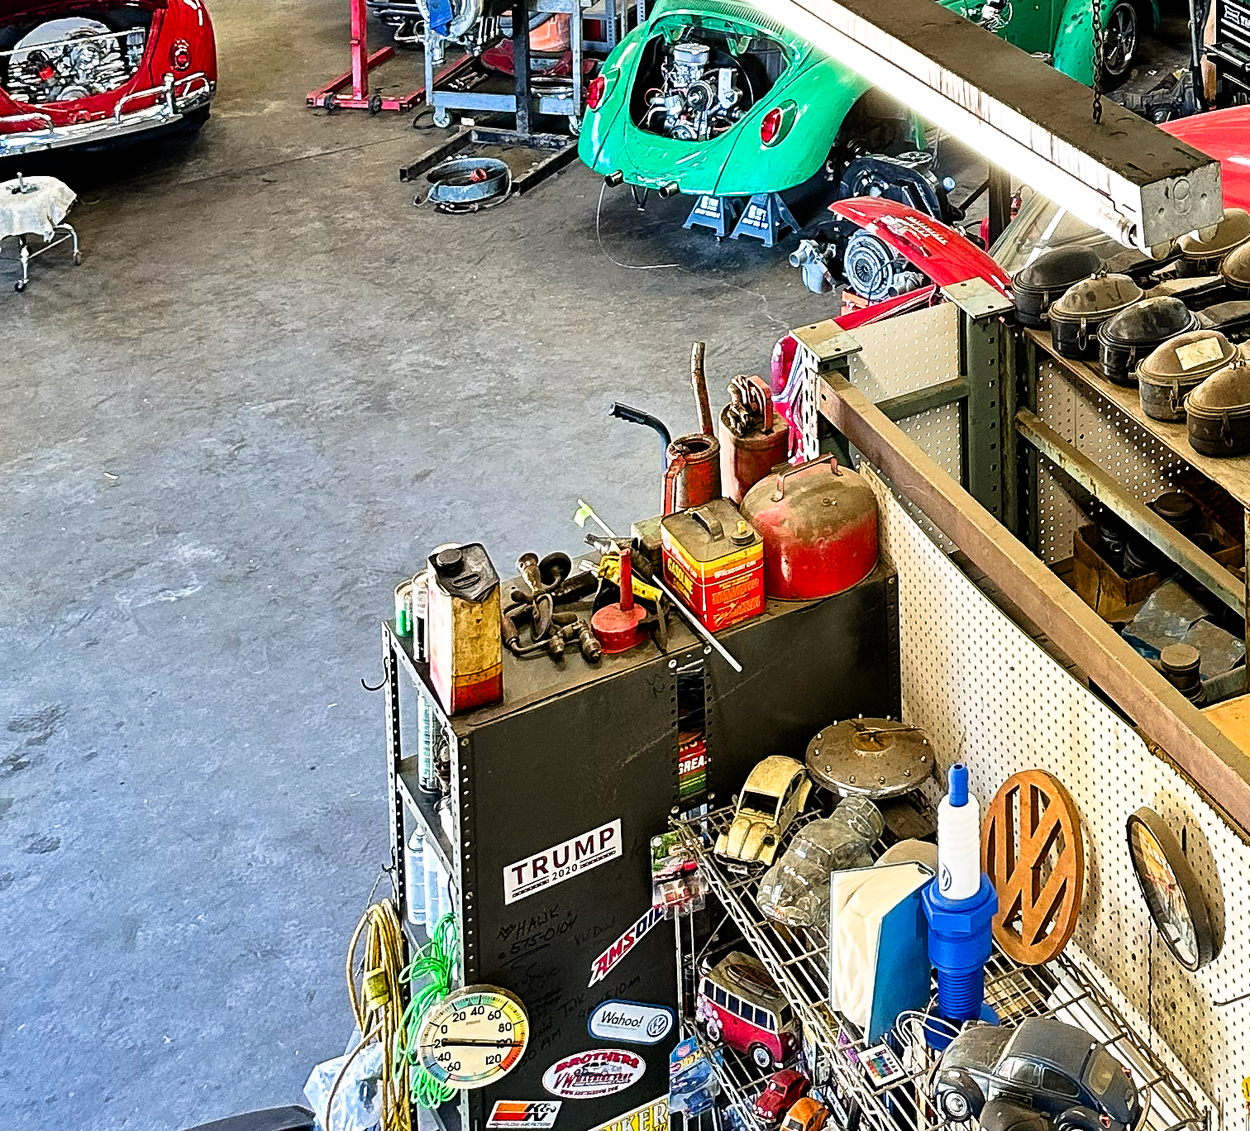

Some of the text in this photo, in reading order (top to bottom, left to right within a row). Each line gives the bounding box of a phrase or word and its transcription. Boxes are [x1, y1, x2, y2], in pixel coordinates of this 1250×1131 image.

[678, 755, 707, 775] GREA
[512, 827, 615, 885] TRUMP
[552, 863, 579, 881] 2020
[593, 906, 664, 980] AMSOIL
[453, 1011, 466, 1022] 20
[470, 1006, 485, 1016] 40
[487, 1010, 501, 1021] 60
[601, 1011, 644, 1027] Wahoo!
[441, 1025, 448, 1034] 0
[498, 1022, 512, 1032] 80
[485, 1054, 501, 1065] 120
[554, 1052, 640, 1074] BROTHERS
